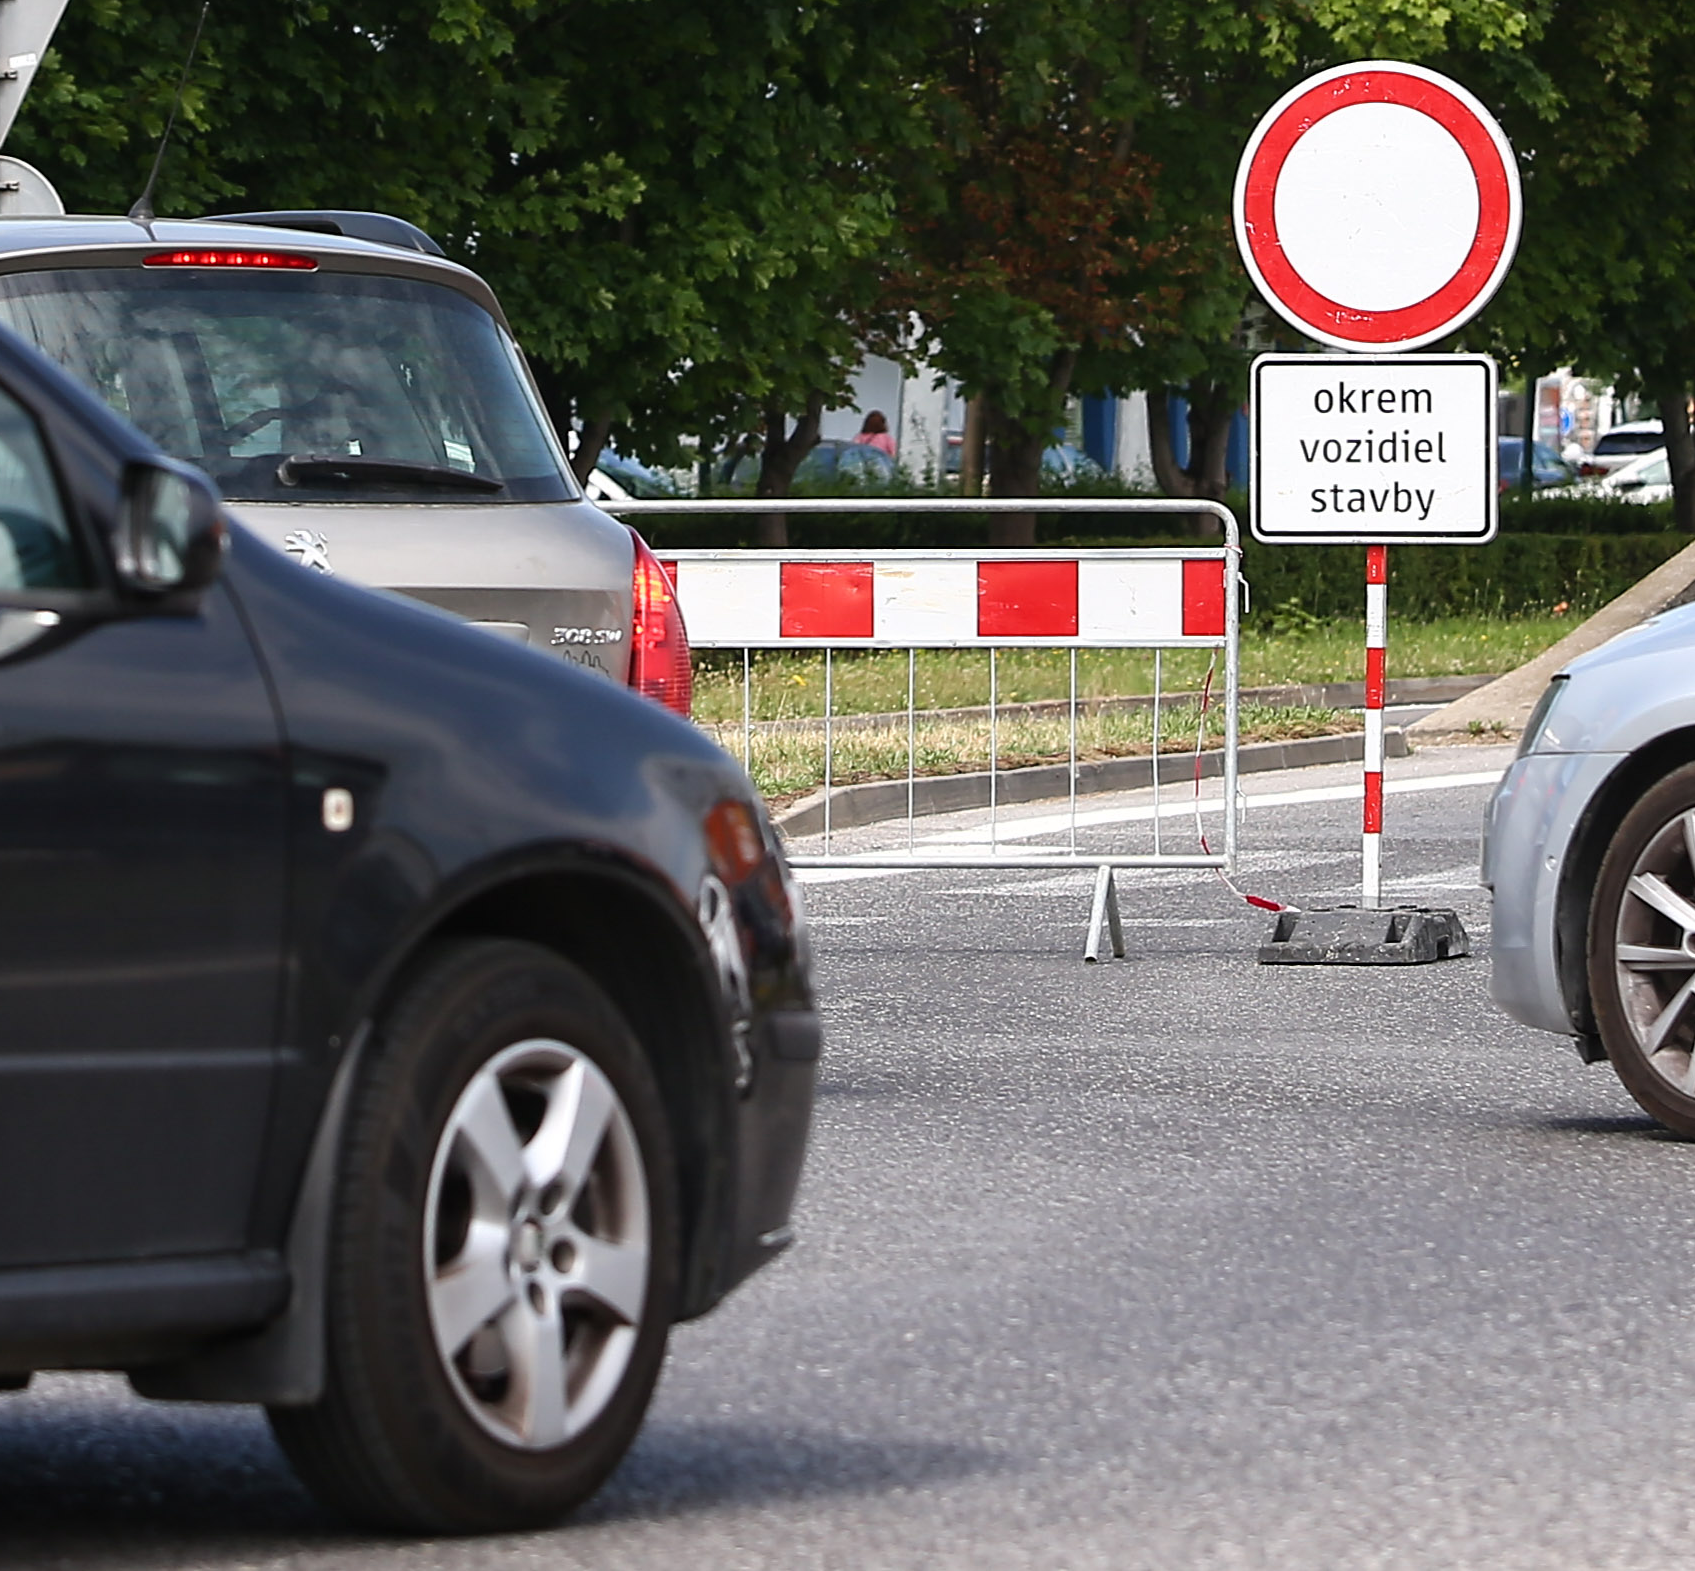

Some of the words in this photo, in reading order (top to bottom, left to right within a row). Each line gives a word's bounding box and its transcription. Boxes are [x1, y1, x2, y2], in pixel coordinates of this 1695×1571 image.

[1314, 381, 1432, 414] okrem
[1300, 429, 1446, 464] vozidiel
[1311, 481, 1435, 521] stavby
[550, 626, 593, 646] 308
